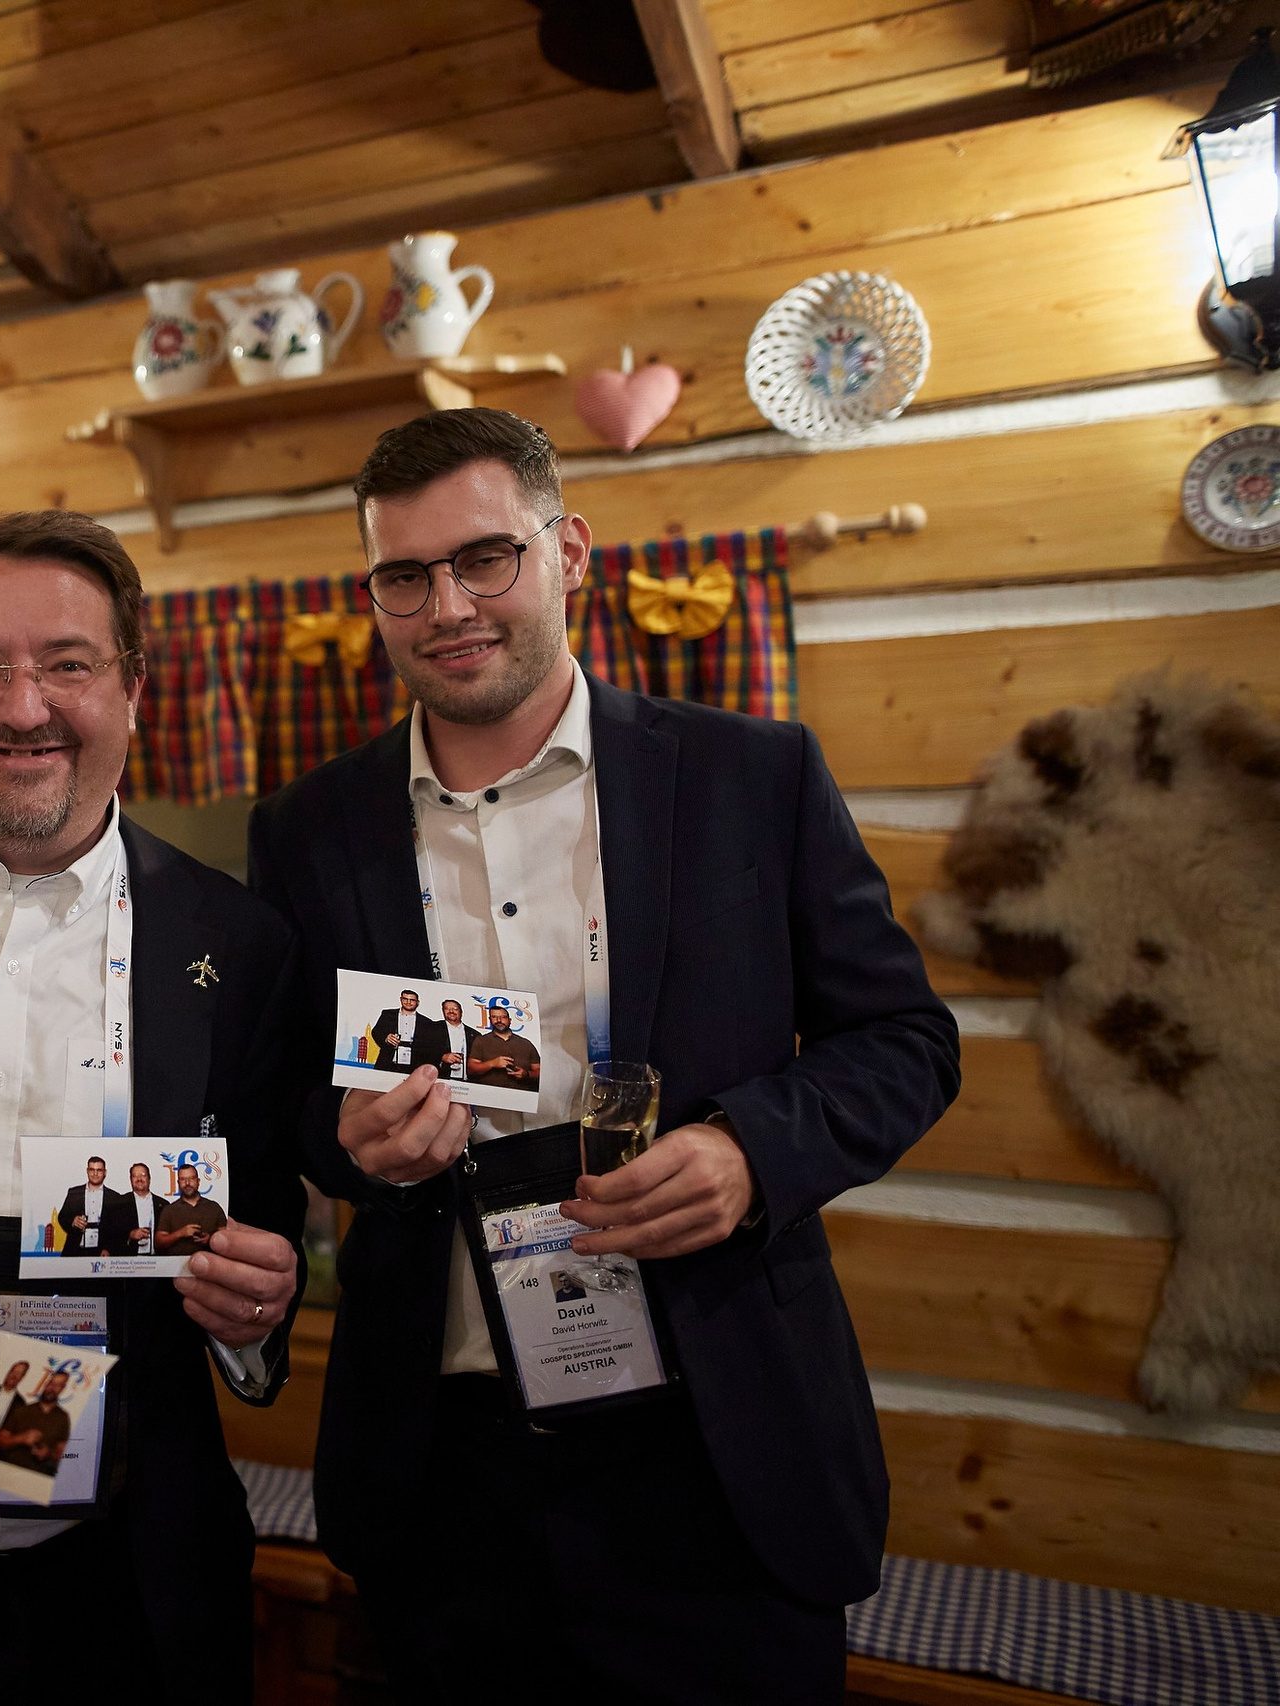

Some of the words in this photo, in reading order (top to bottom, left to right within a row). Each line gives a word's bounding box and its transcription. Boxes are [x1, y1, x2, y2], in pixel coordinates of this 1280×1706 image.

[119, 874, 127, 899] NYS
[589, 932, 599, 962] NYS
[430, 952, 442, 980] NYS
[114, 1022, 123, 1050] NYS
[531, 1208, 561, 1219] InFinit
[532, 1240, 573, 1254] DELEGA
[519, 1277, 539, 1290] 148
[20, 1300, 53, 1309] InFinite
[53, 1301, 97, 1310] Connection
[557, 1303, 596, 1320] David
[29, 1310, 56, 1318] Annual
[57, 1310, 96, 1319] Conference
[551, 1324, 576, 1335] David
[577, 1318, 609, 1331] Horwitz
[540, 1354, 572, 1365] LOGSPED
[573, 1346, 612, 1359] SPEDITIONS
[612, 1342, 633, 1351] GMBH
[563, 1356, 617, 1375] AUSTRIA
